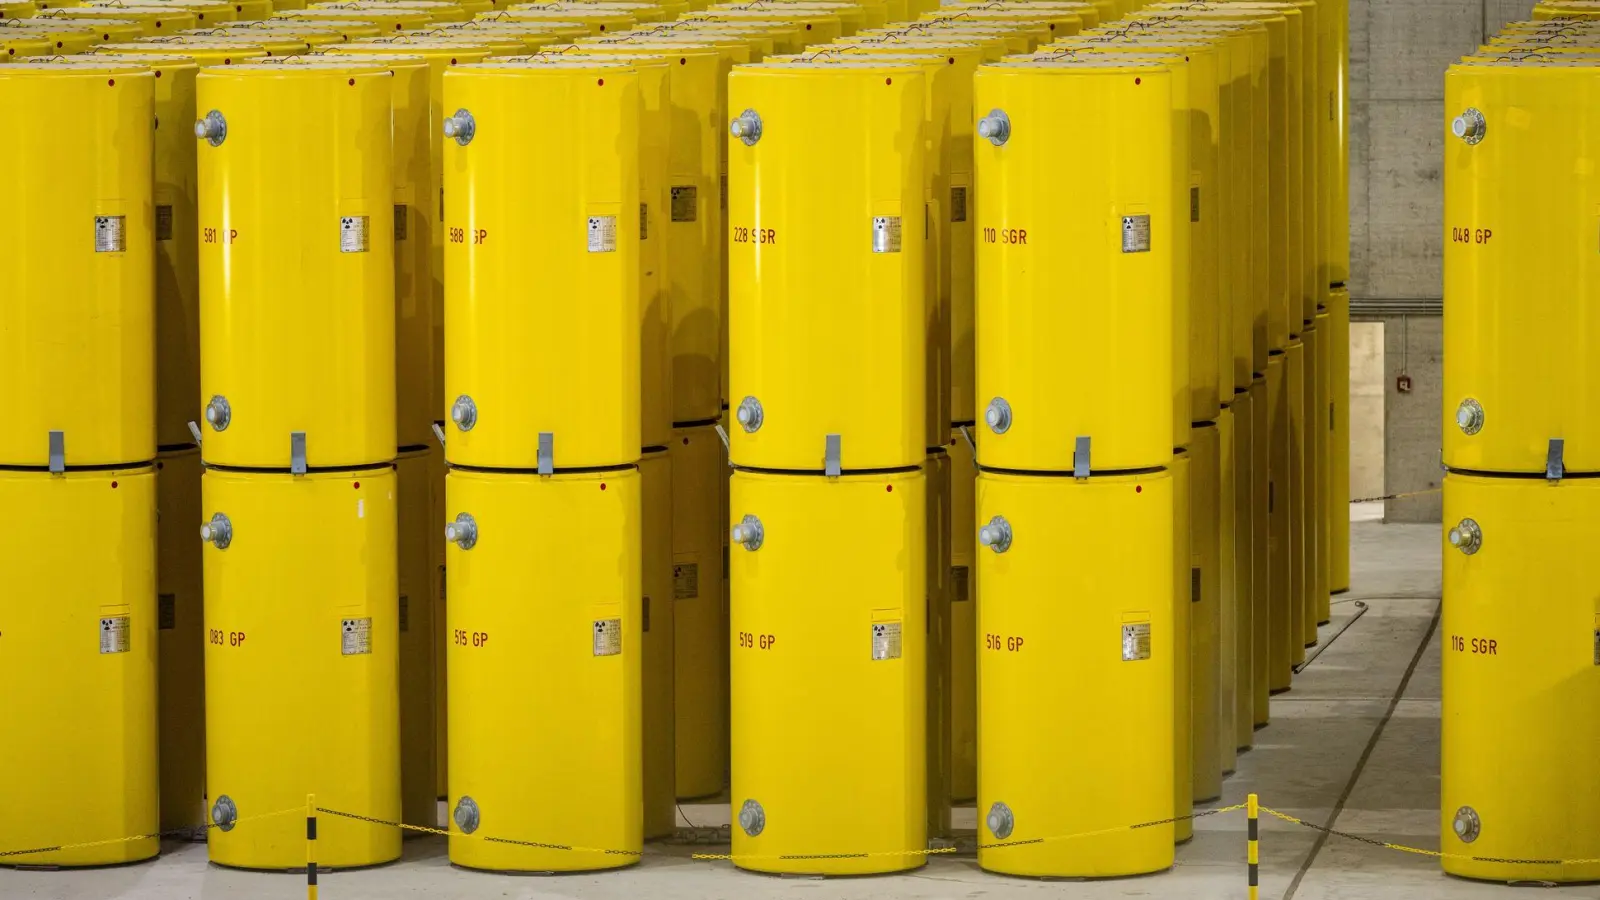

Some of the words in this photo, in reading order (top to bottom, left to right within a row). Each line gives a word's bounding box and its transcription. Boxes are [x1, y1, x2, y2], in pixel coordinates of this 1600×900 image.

[204, 227, 217, 244] 581
[223, 229, 238, 245] P
[449, 227, 464, 244] 588
[733, 227, 748, 243] 228
[751, 228, 776, 245] SGR
[983, 227, 996, 244] 110
[1001, 228, 1028, 245] SGR
[1452, 227, 1470, 244] 048
[1475, 228, 1493, 245] GP
[210, 628, 224, 646] 083
[229, 631, 246, 647] GP
[454, 629, 468, 646] 515
[472, 632, 489, 648] GP
[739, 631, 754, 649] 519
[759, 634, 776, 650] GP
[986, 633, 1002, 650] 516
[1007, 636, 1025, 652] GP
[1451, 635, 1465, 653] 116
[1471, 637, 1498, 656] SGR
